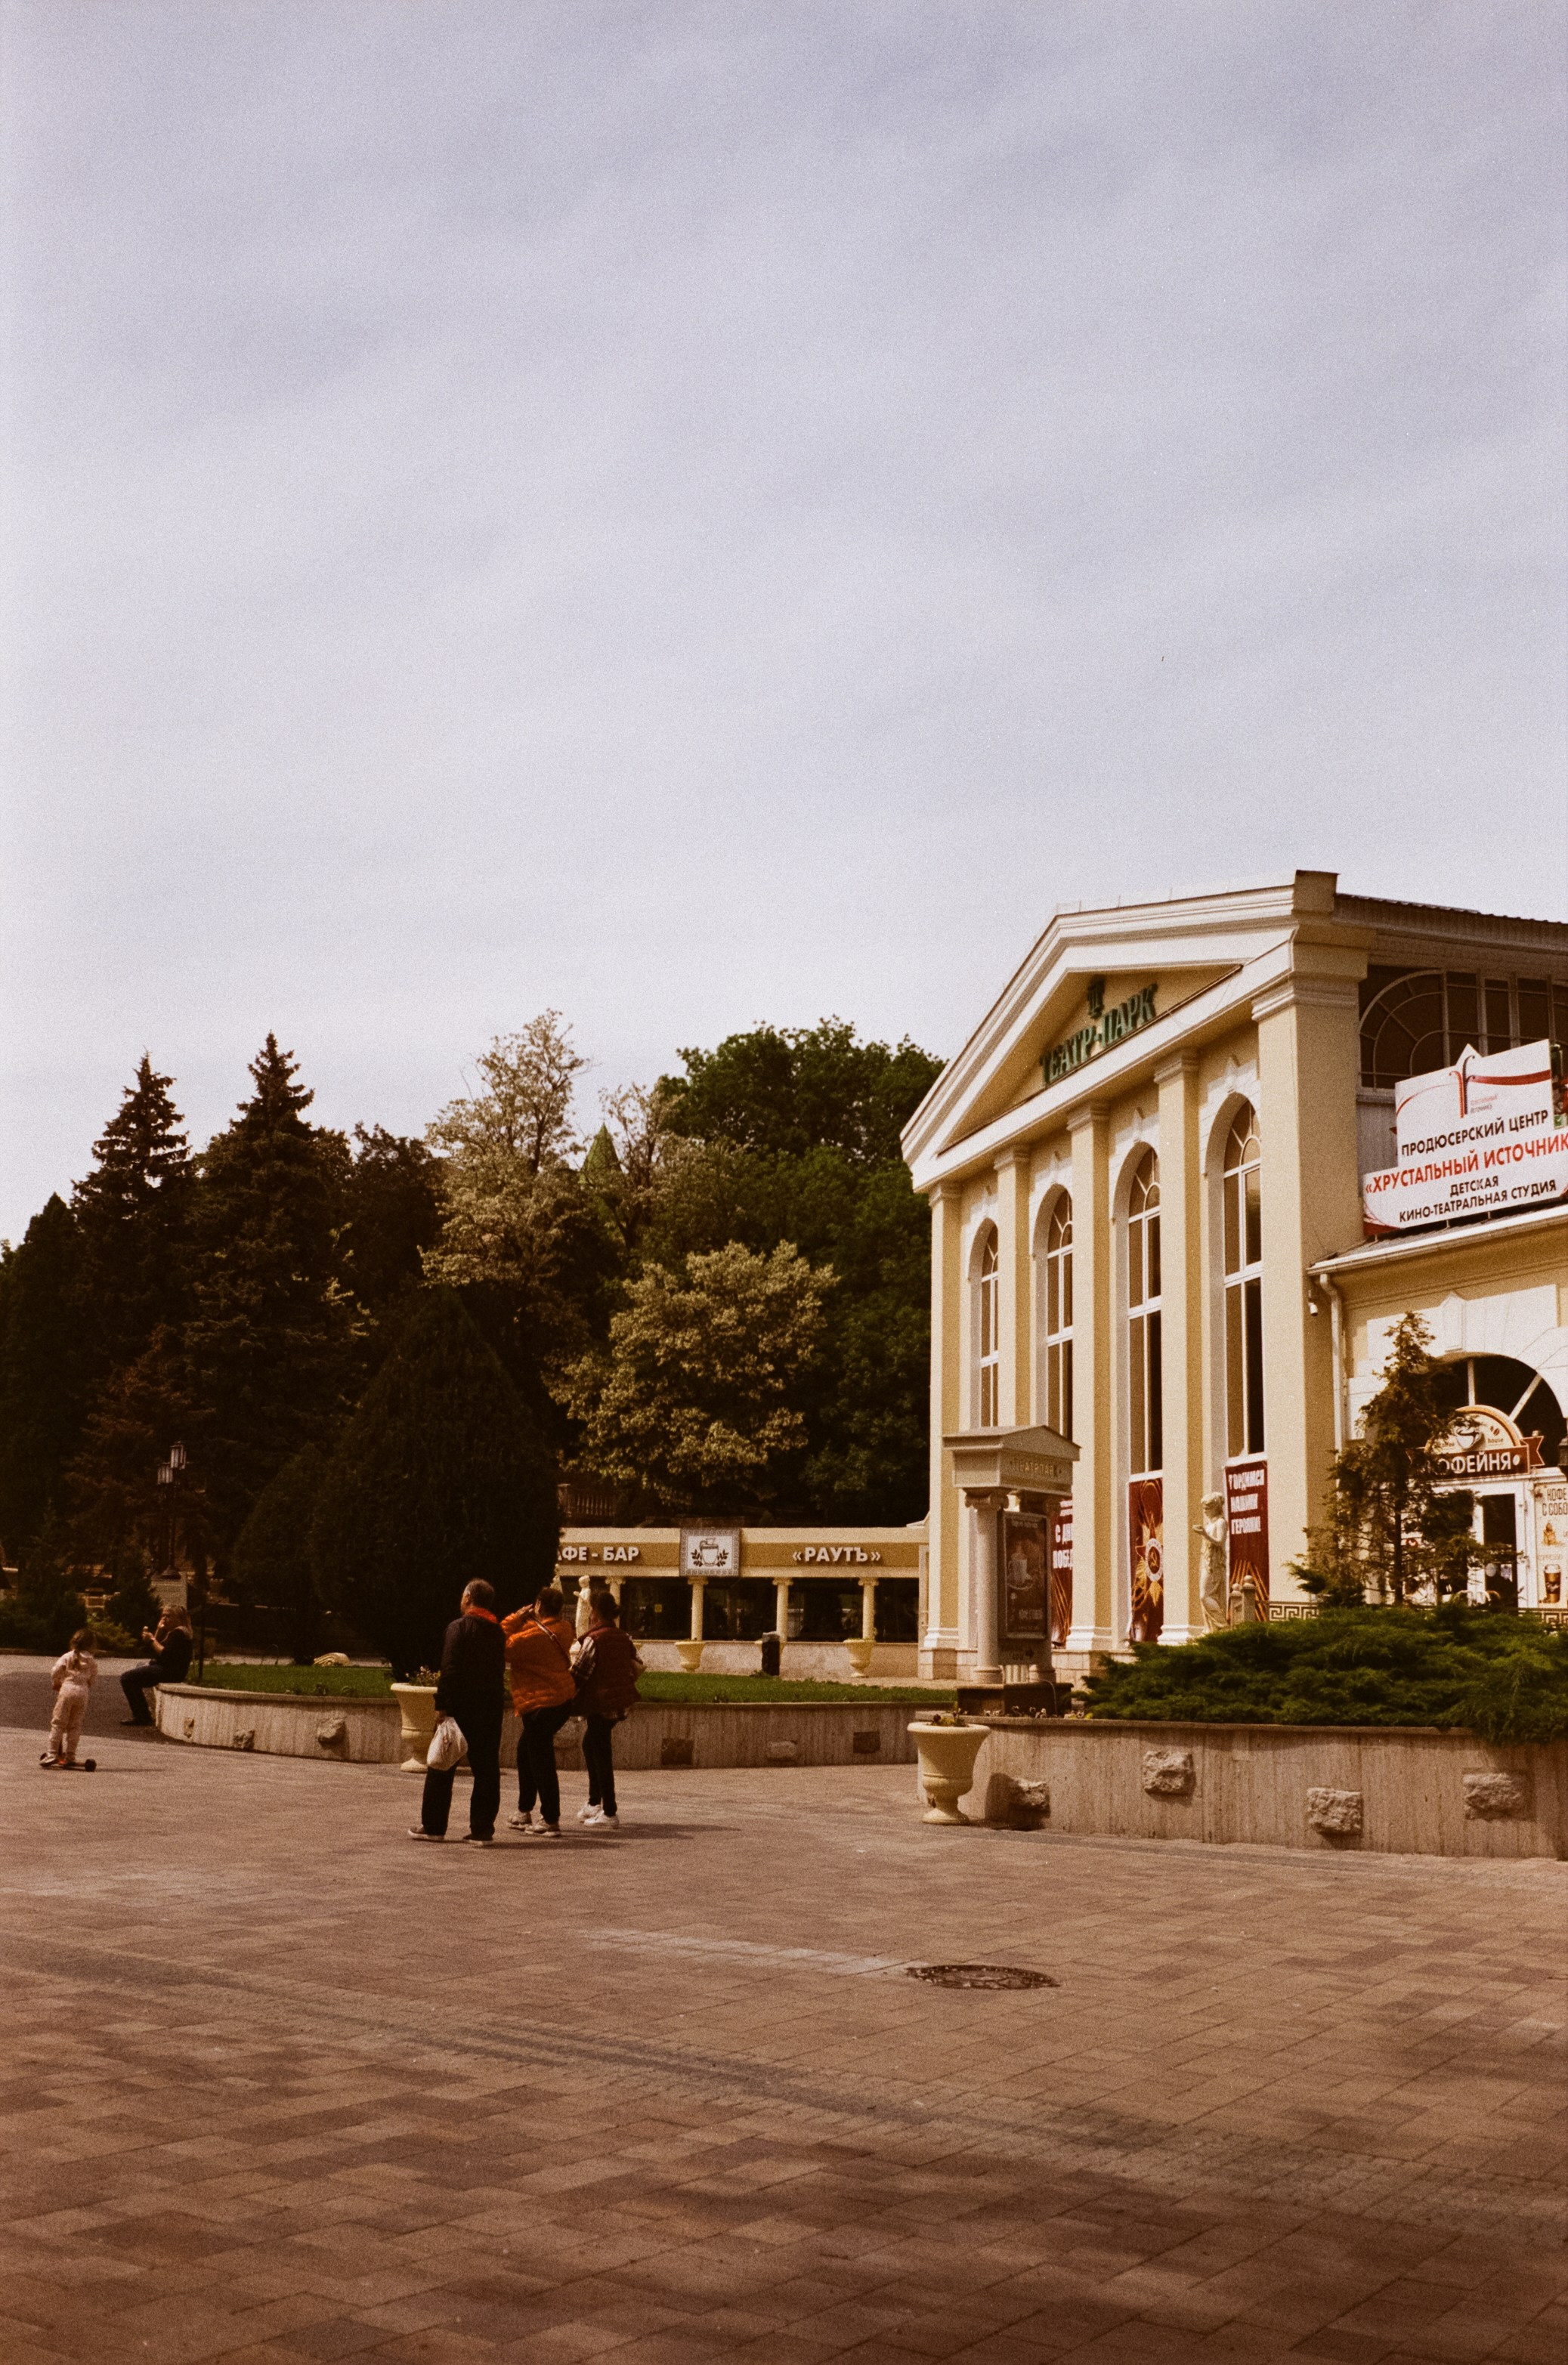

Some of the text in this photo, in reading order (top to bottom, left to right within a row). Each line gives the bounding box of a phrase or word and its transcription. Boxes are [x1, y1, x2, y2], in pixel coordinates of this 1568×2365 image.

[1401, 1108, 1549, 1157] ПРОДЮСЕРСКИЙ ЦЕНТР
[1365, 1150, 1479, 1194] «ХРУСТАЛЬНЫЙ
[1449, 1176, 1499, 1198] ДЕТСКАЯ
[1399, 1179, 1557, 1223] КИНО-ТЕАТРАЛЬНАЯ СТУДИЯ
[1427, 1450, 1511, 1477] ОФЕЙНЯ
[1548, 1501, 1568, 1516] СОБО
[1055, 1524, 1061, 1543] С
[558, 1547, 587, 1561] ФЕ
[603, 1547, 639, 1561] БАР
[792, 1546, 881, 1564] «РАУТЪ»
